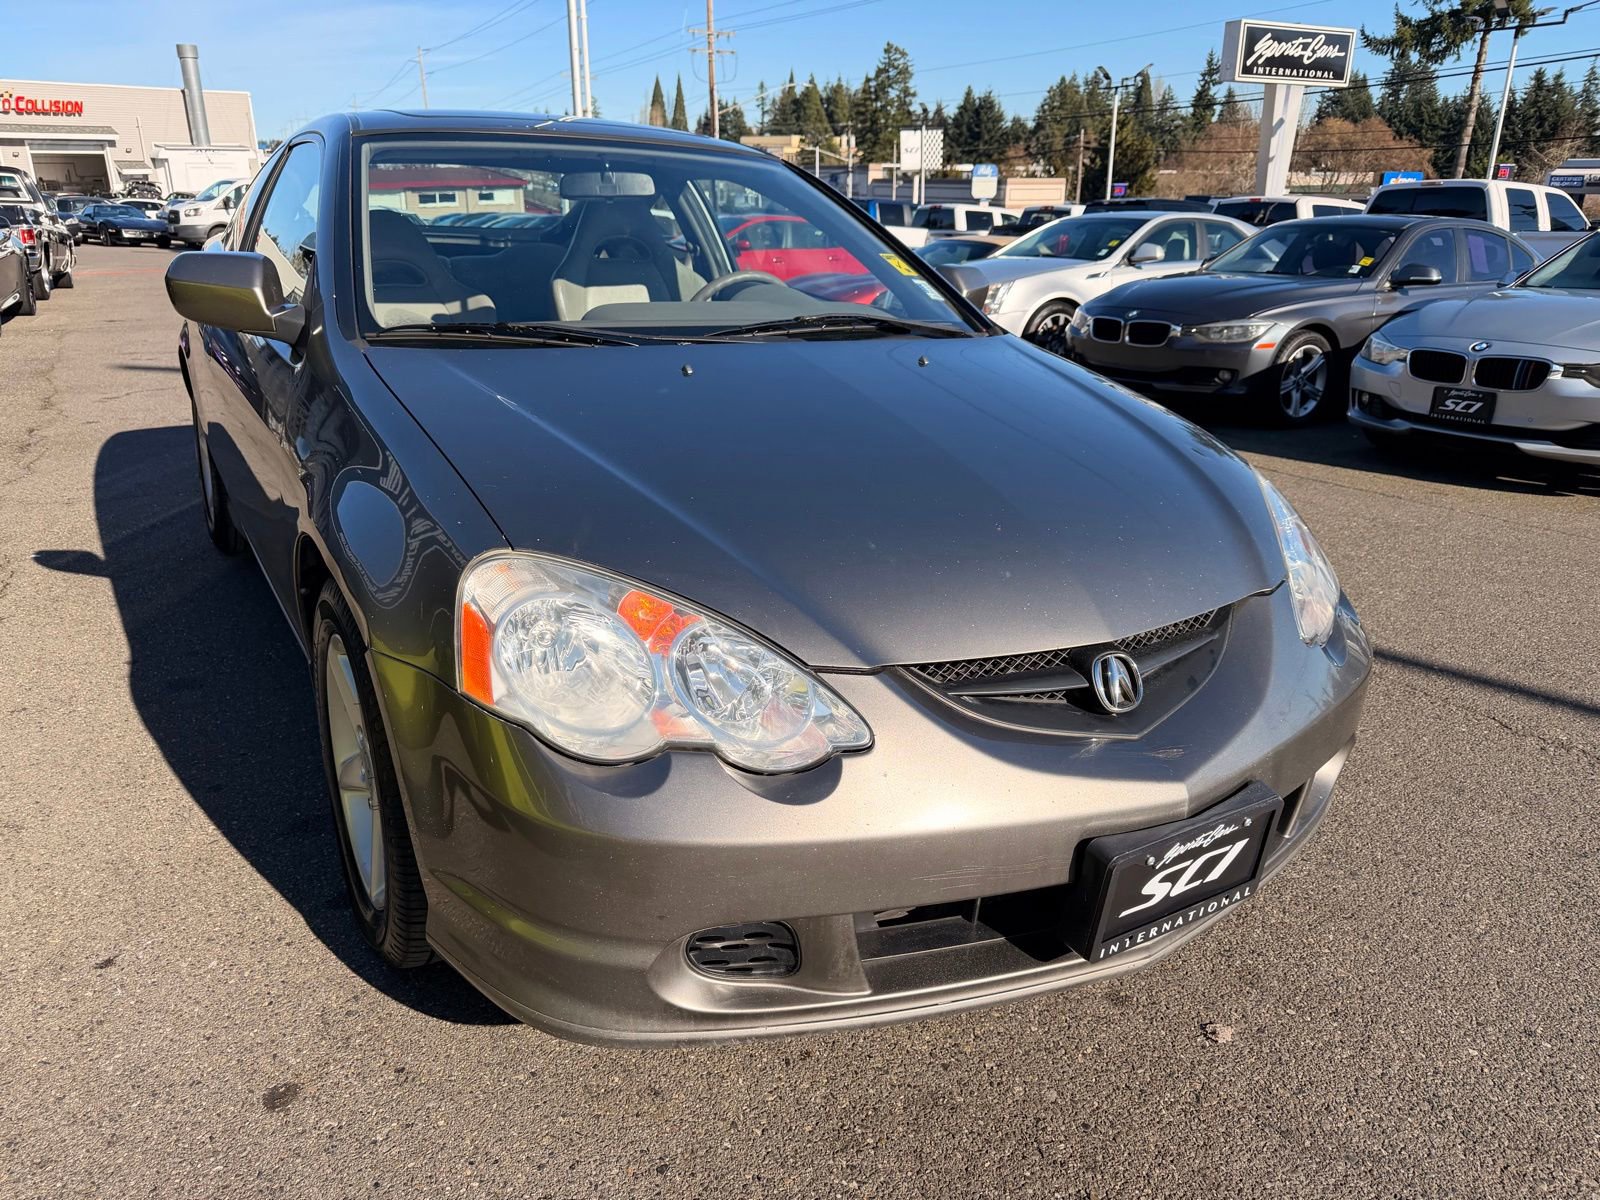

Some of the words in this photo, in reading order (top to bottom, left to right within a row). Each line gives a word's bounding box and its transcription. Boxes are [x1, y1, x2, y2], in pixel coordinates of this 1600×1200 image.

[1246, 33, 1312, 66] Sports
[1302, 34, 1345, 65] Cars
[1253, 66, 1334, 79] INTERNATIONAL
[15, 96, 83, 113] COLLISION
[1430, 412, 1486, 424] INTERNATIONAL
[1438, 399, 1484, 413] SCI
[1155, 831, 1212, 869] Sports
[1118, 838, 1250, 918] SCI
[1099, 887, 1251, 958] INTERNATIONAL
